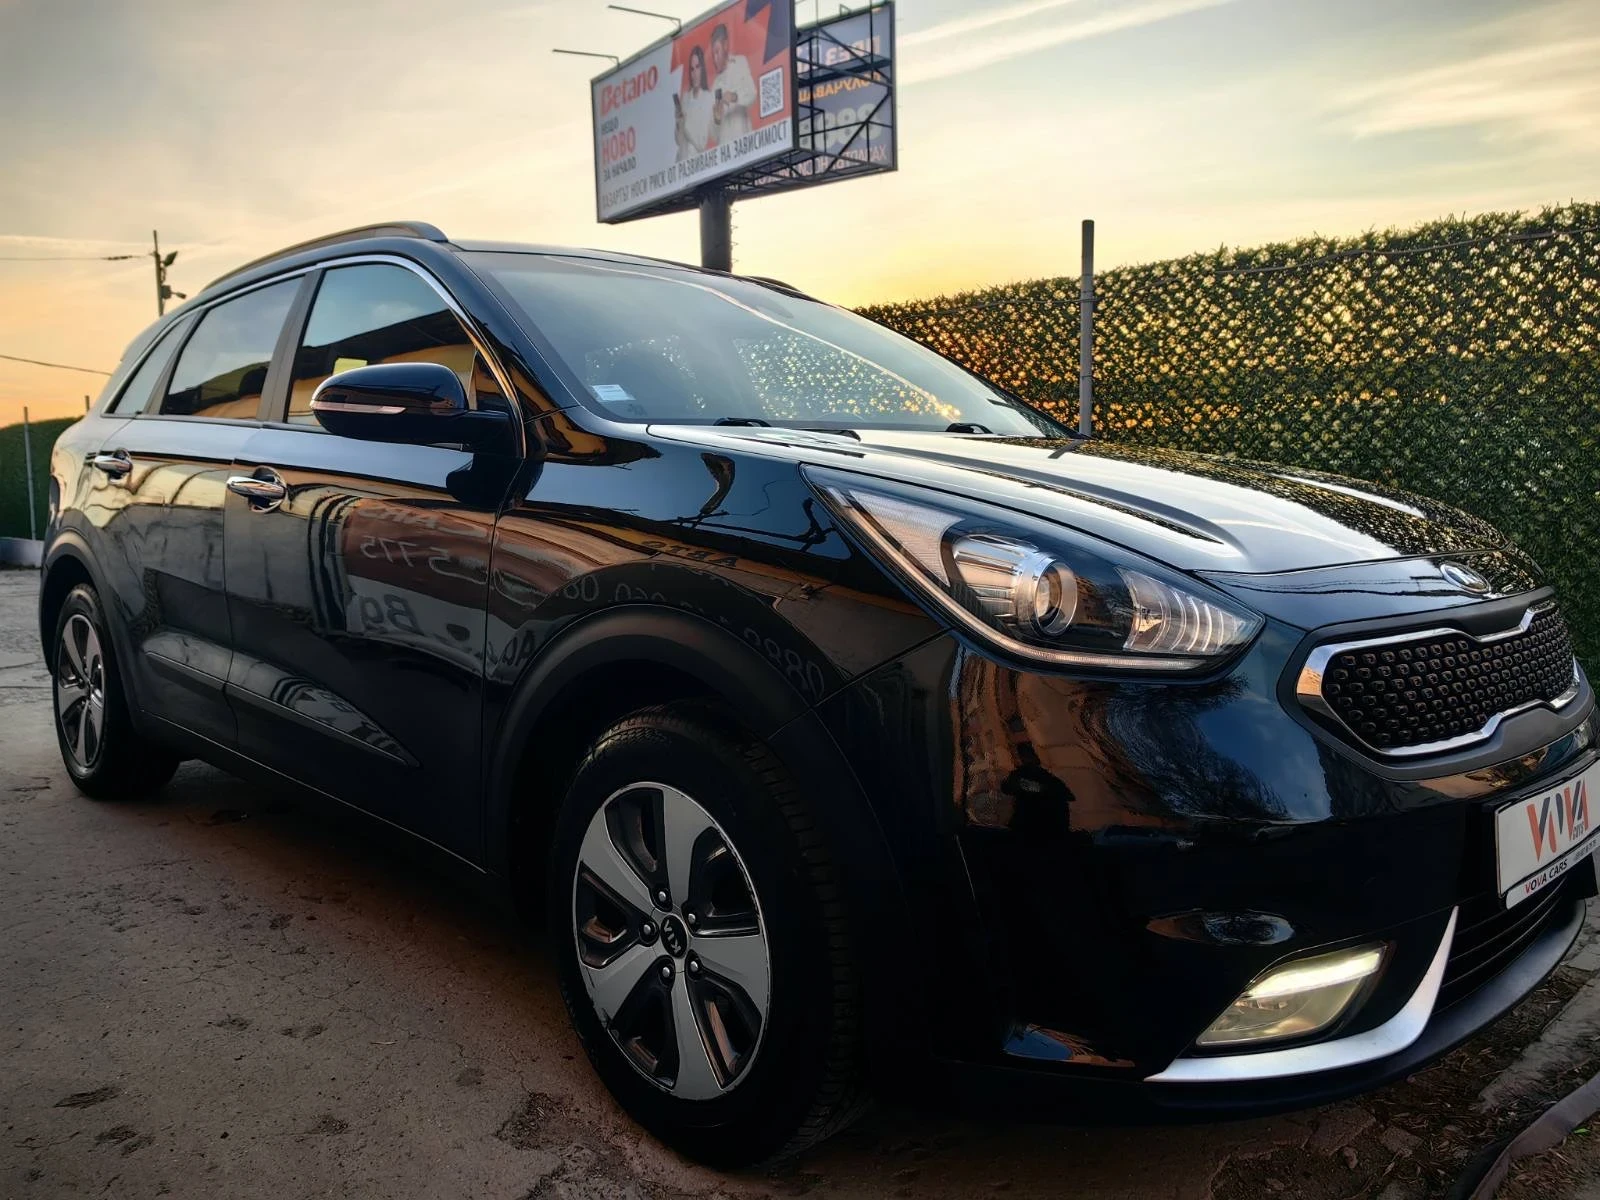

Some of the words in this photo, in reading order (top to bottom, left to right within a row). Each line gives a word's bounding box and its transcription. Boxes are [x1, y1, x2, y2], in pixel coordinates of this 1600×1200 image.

[601, 65, 658, 117] Betano
[602, 126, 636, 166] НОВО
[630, 177, 648, 199] НОСИ
[649, 169, 666, 191] РИСК
[667, 165, 677, 184] ОТ
[677, 148, 718, 181] РАЗВИВАНЕ
[720, 145, 731, 162] НА
[734, 120, 788, 159] ЗАВИСИМОСТ
[603, 169, 611, 182] ЗА
[612, 156, 637, 179] НАЧАЛО
[1524, 875, 1547, 894] VOVA
[1549, 859, 1568, 878] CARS
